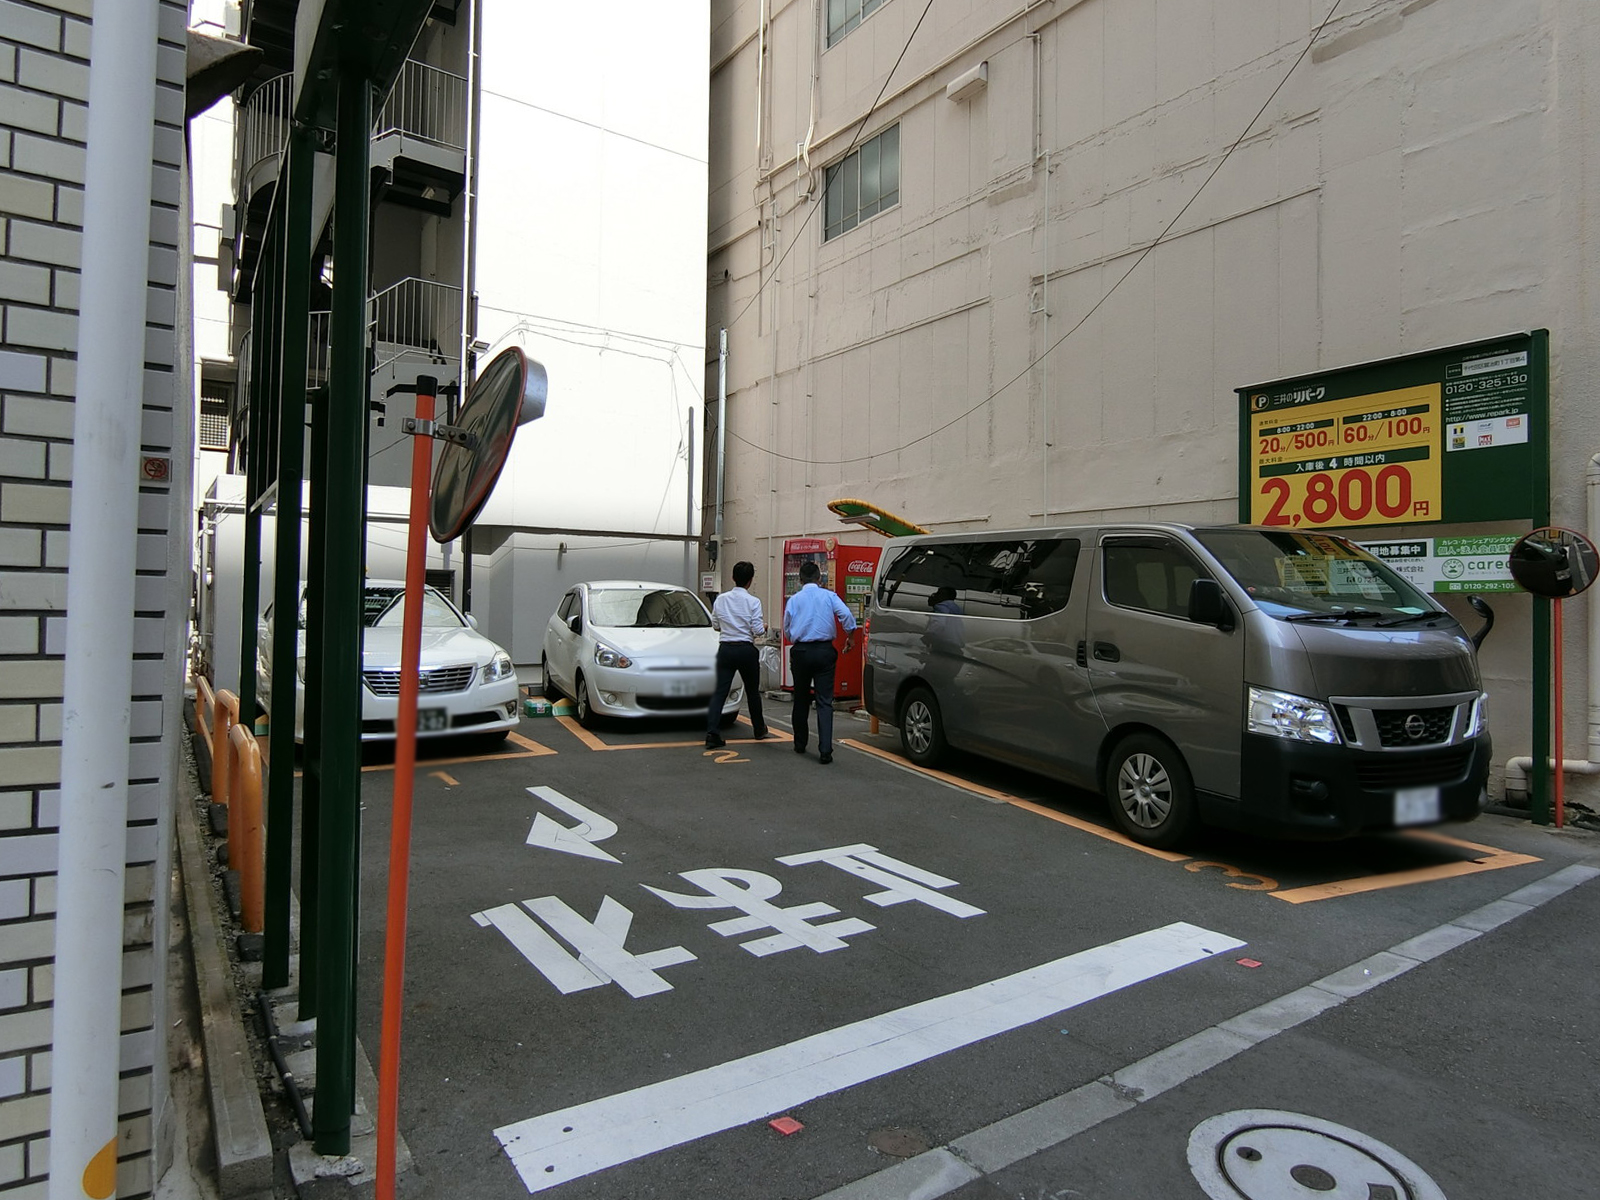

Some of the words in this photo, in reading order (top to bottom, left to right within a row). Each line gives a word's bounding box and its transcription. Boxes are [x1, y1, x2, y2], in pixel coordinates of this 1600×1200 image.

[1445, 374, 1528, 395] 0120-325-130
[1273, 386, 1326, 405] 三井のリパーク
[1445, 407, 1519, 423] http://www.repark.jp
[1295, 460, 1325, 472] 入庫後
[1328, 457, 1338, 469] 4
[1343, 453, 1385, 467] 時間以内
[1441, 536, 1523, 546] カレコ・カーシェアリングクラ
[1467, 560, 1510, 570] carec
[1463, 582, 1515, 590] 0120-292-105
[702, 750, 751, 764] 2
[1184, 861, 1279, 891] 3
